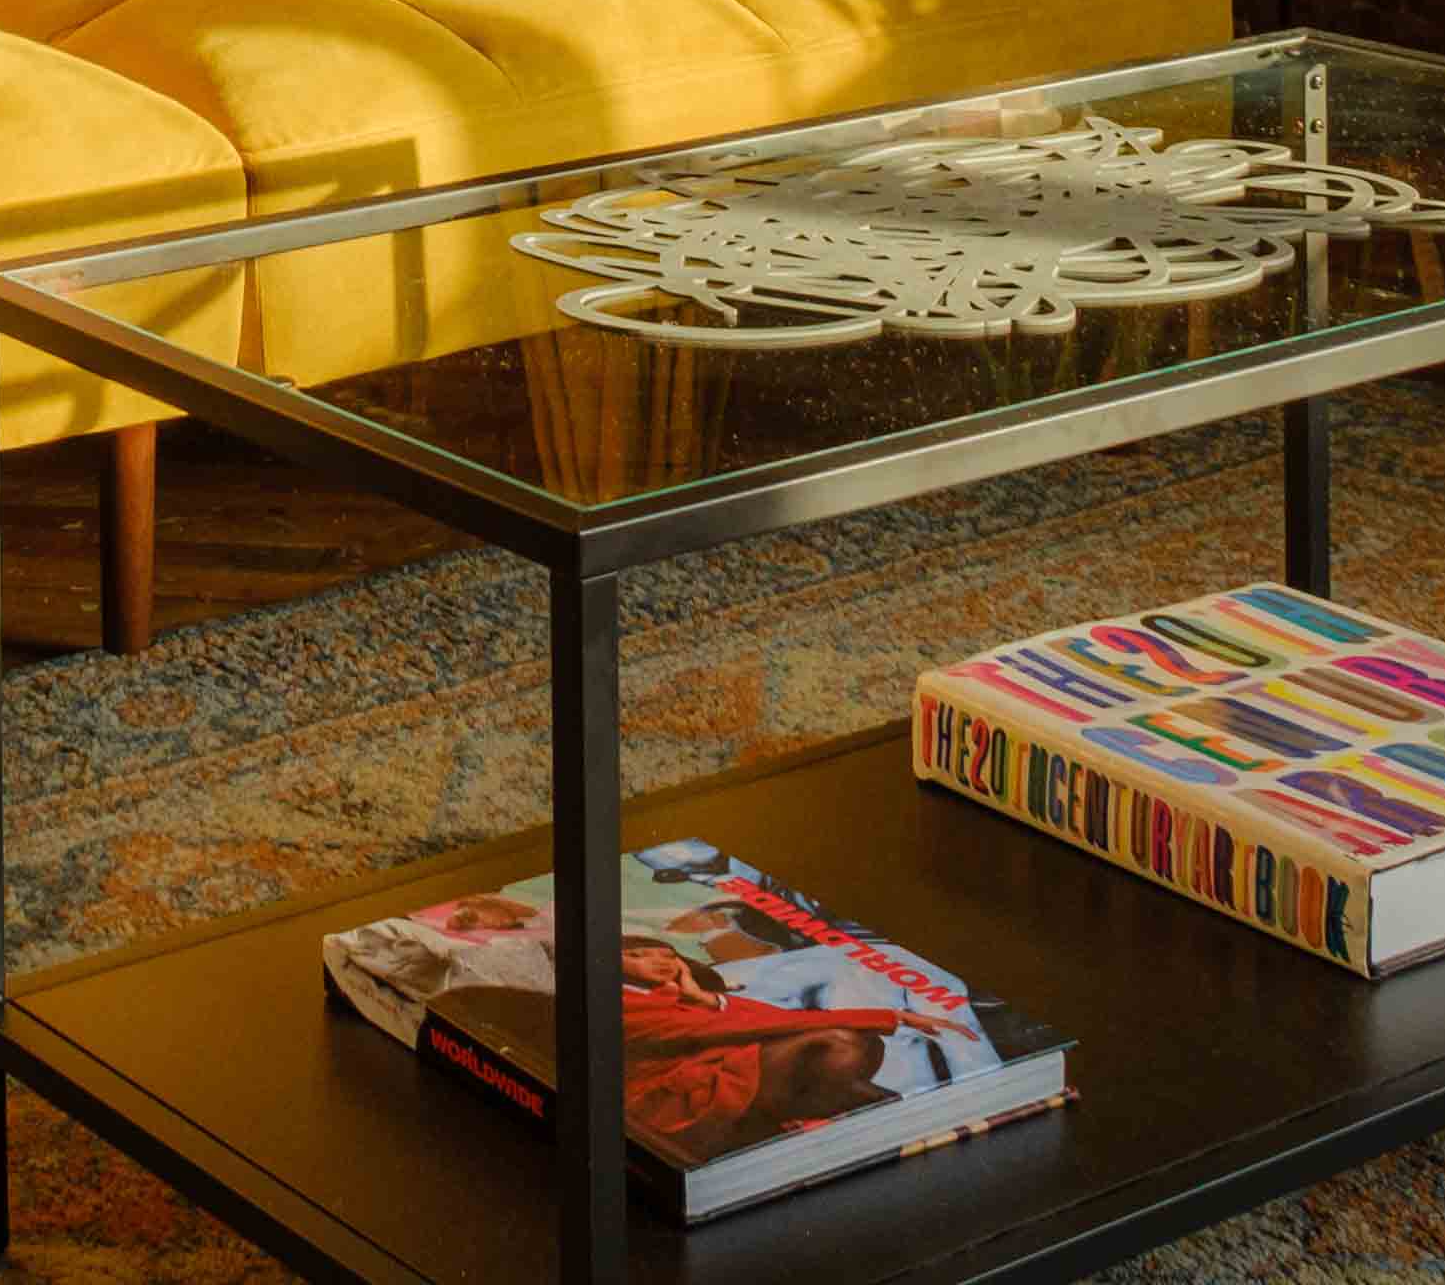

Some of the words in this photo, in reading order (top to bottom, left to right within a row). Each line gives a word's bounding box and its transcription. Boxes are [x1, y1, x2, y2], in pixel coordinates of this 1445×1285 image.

[947, 636, 1199, 723] THE
[714, 876, 969, 1012] WORLDWIDE
[429, 1028, 544, 1119] WORLDWIDE
